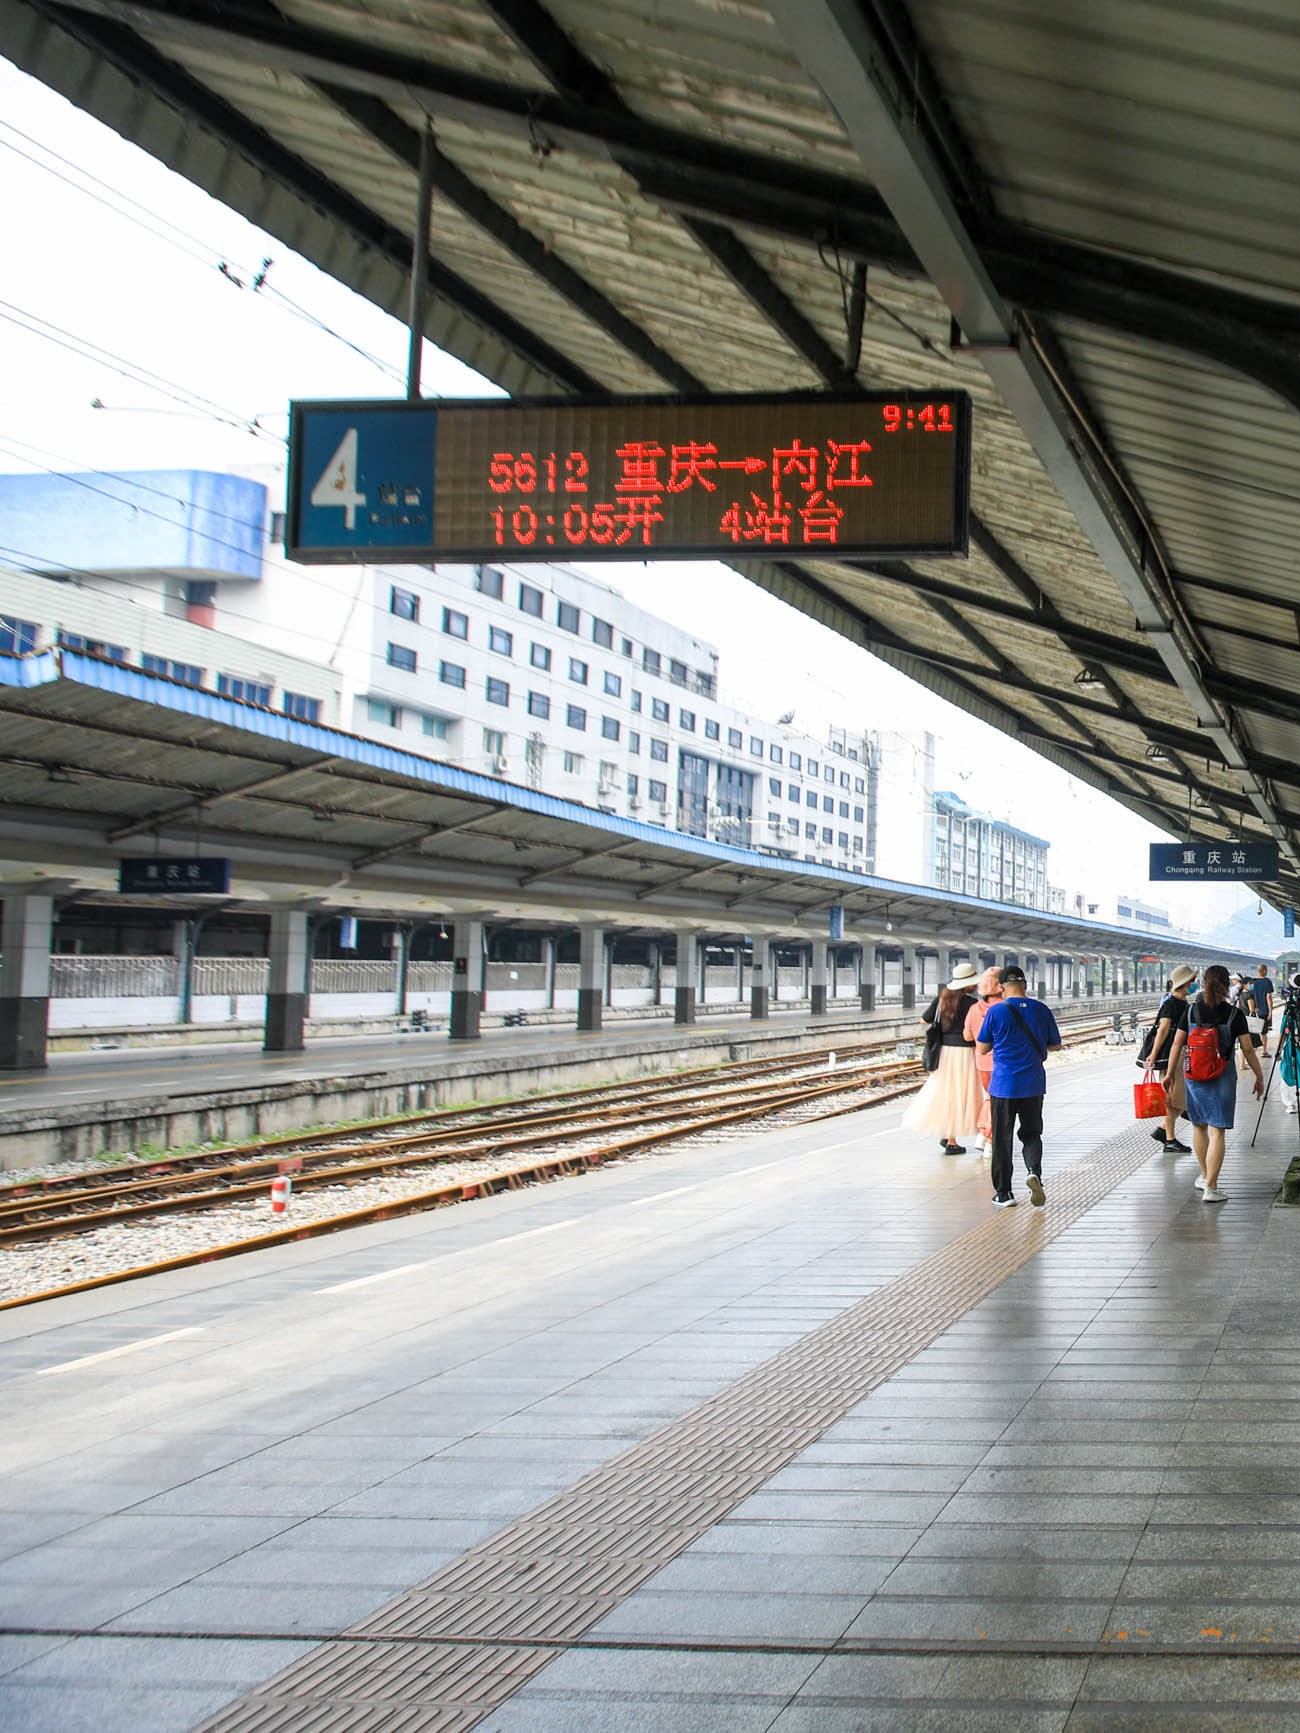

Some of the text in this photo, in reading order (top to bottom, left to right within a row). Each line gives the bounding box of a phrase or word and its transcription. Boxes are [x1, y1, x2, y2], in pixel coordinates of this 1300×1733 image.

[883, 404, 953, 431] 9:41
[311, 428, 367, 530] 4
[488, 438, 873, 493] 5612 重庆 内江
[490, 491, 844, 545] 10:05开 4站台
[1165, 866, 1205, 874] Chongqing
[1207, 866, 1235, 874] Railway
[1181, 850, 1247, 865] 重庆站
